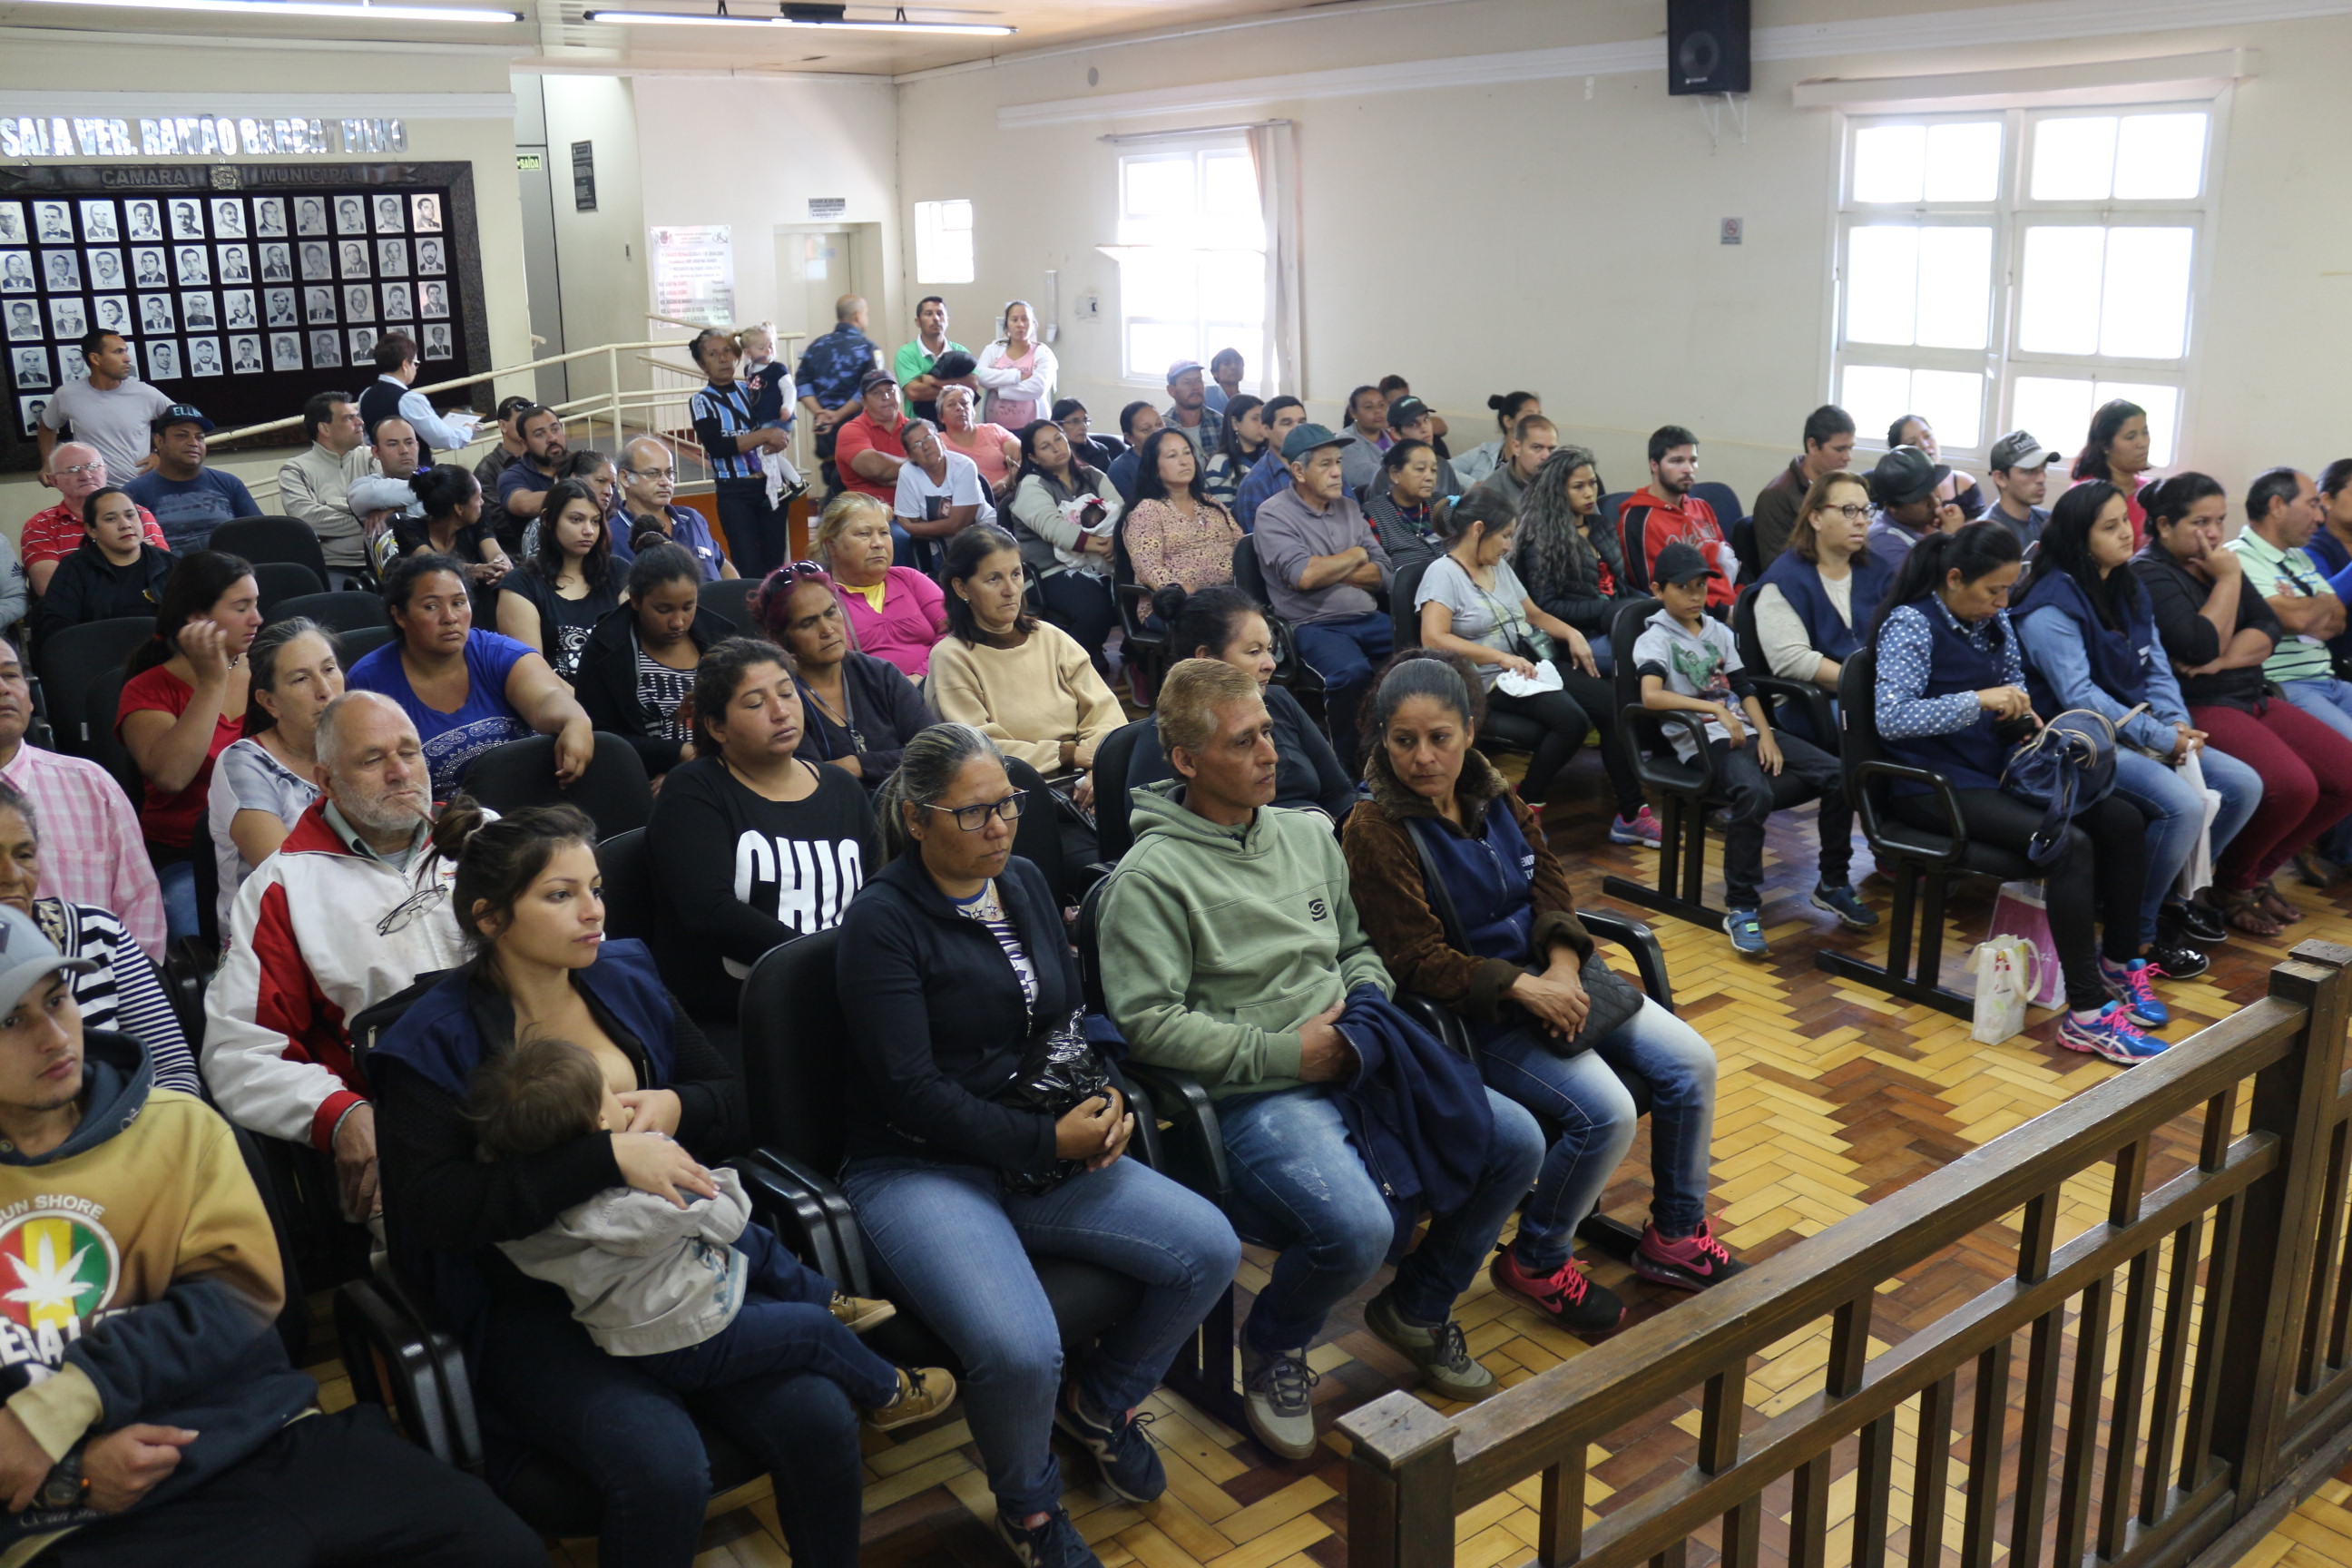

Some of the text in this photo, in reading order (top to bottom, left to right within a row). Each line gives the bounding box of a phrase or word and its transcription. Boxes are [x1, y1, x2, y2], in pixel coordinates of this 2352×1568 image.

[0, 117, 75, 157] SALA
[73, 117, 138, 156] VER.
[0, 1194, 105, 1225] UN SHORE
